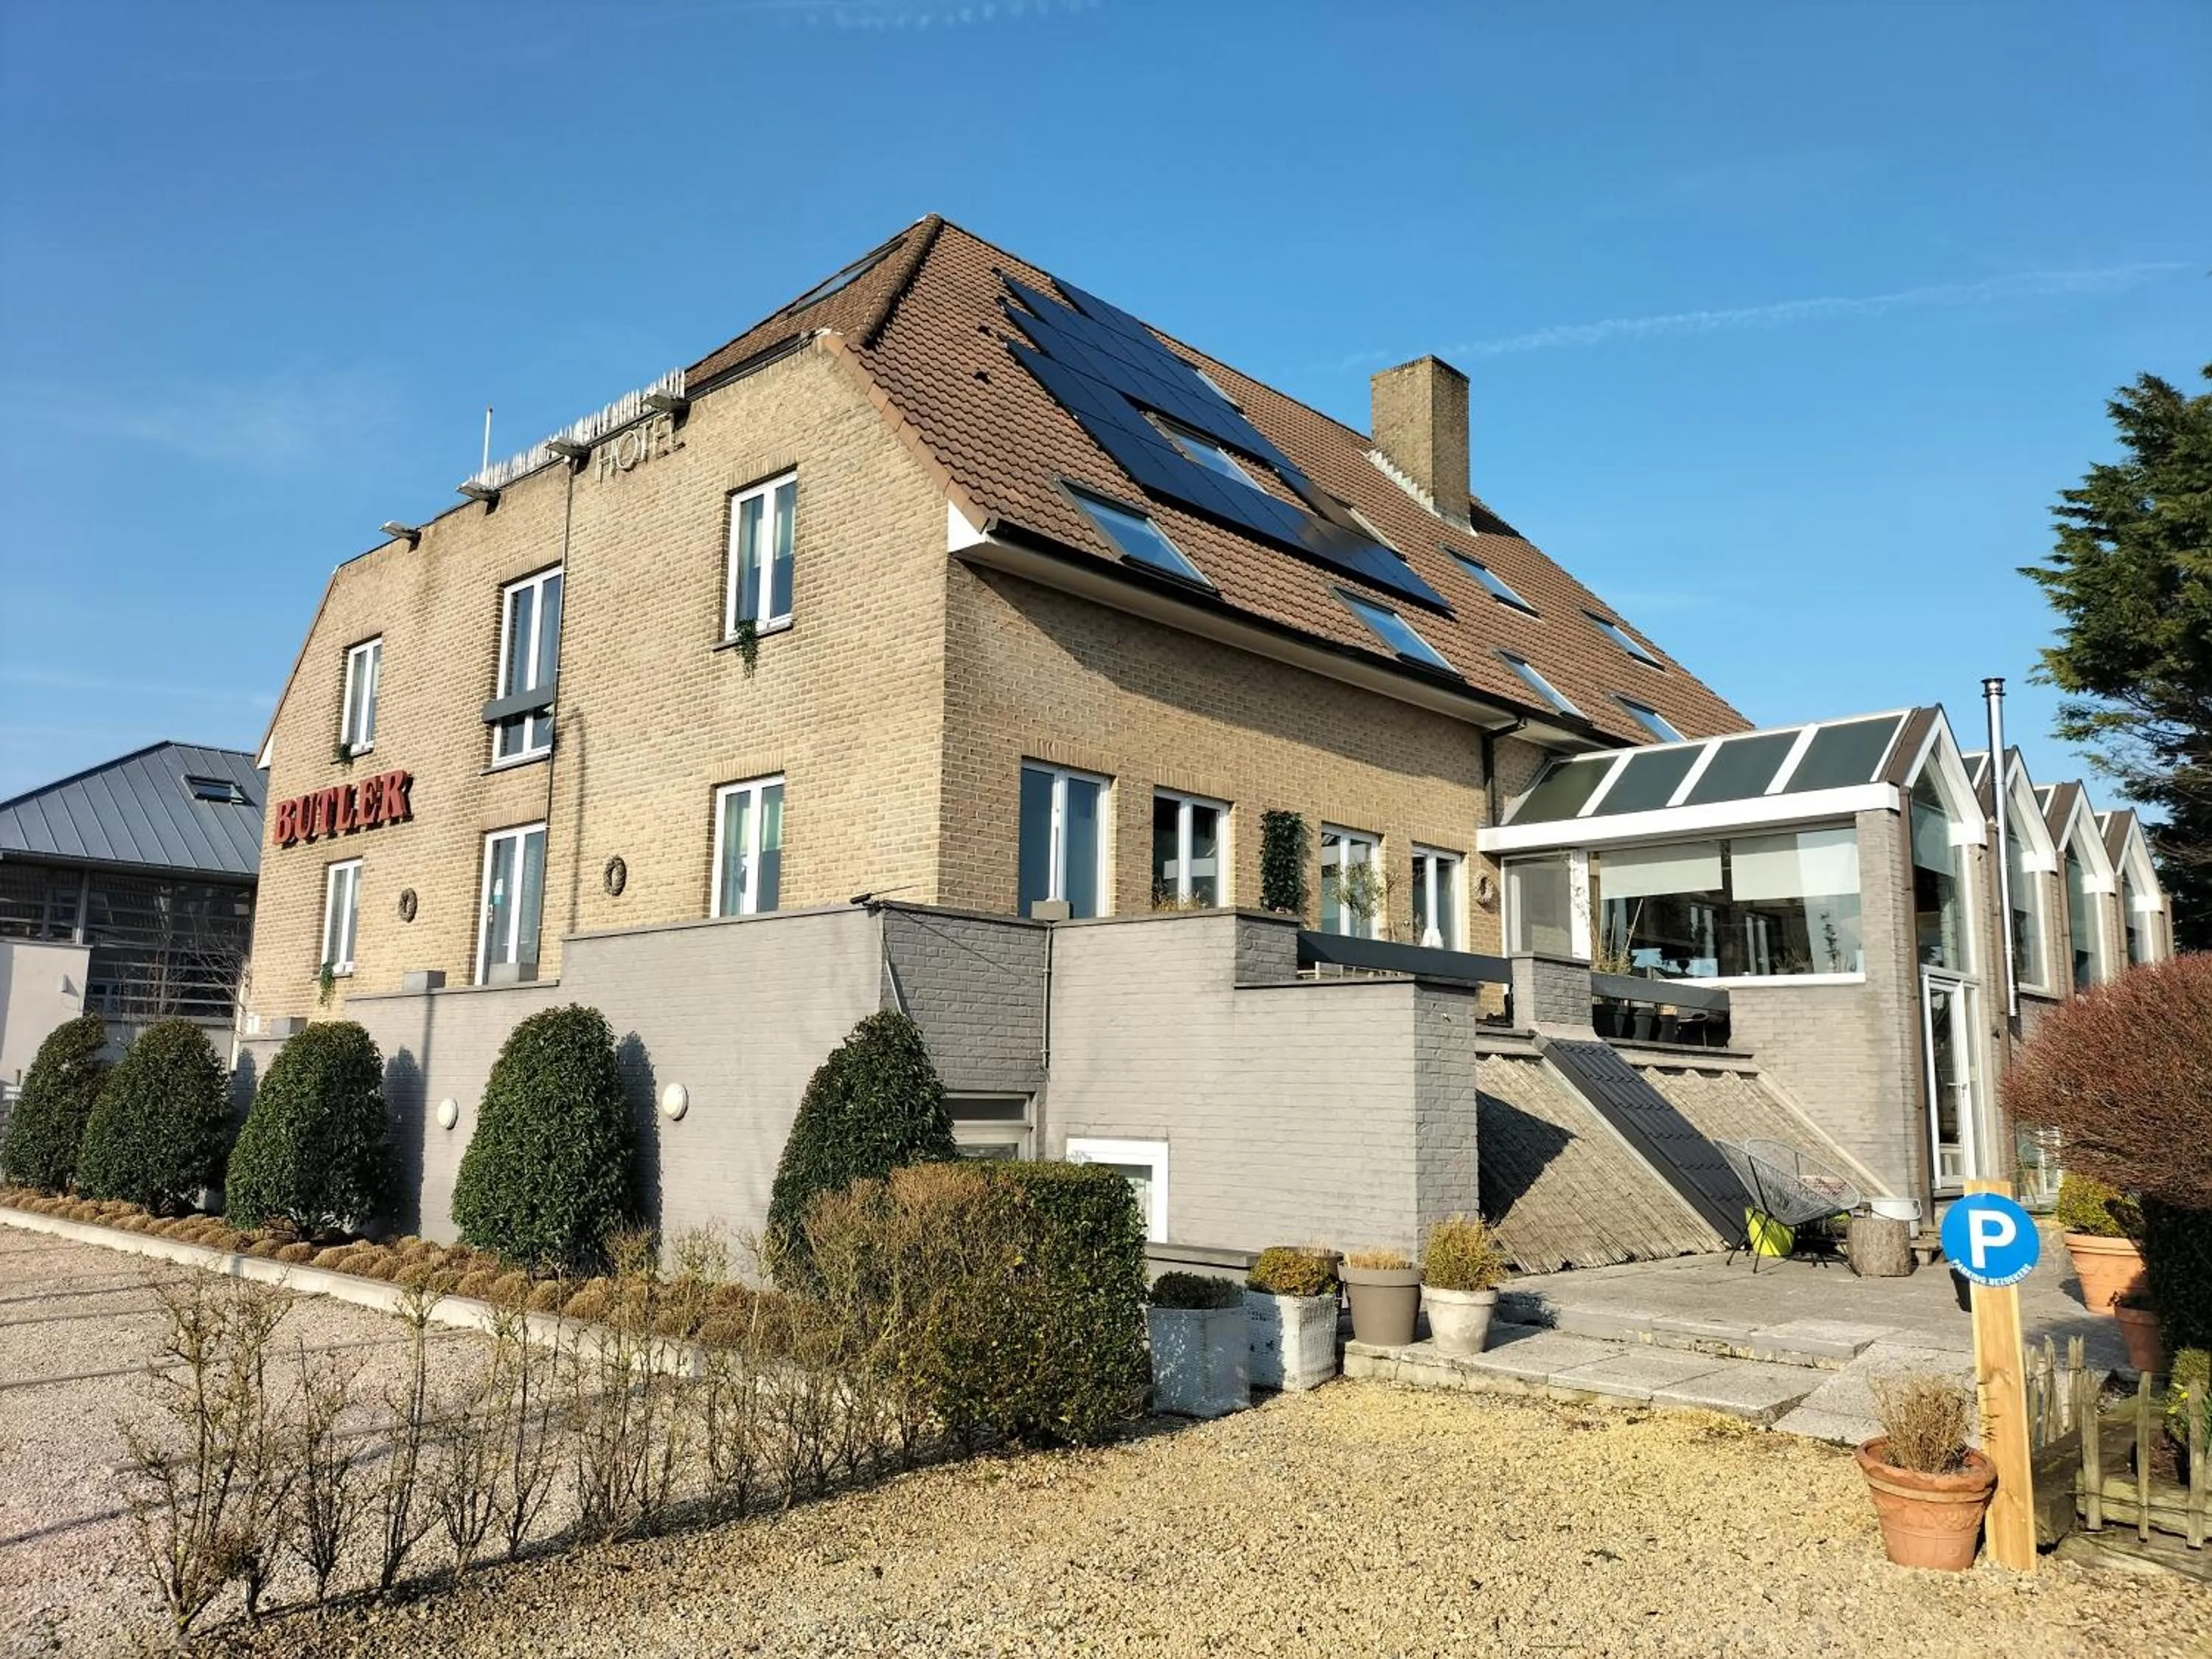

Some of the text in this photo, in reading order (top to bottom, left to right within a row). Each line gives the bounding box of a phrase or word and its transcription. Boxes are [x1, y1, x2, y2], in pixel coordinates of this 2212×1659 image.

[596, 411, 686, 484] HOTEL
[272, 769, 411, 846] BUTLER
[1952, 1259, 1987, 1284] PARKING
[1968, 1209, 2017, 1269] P
